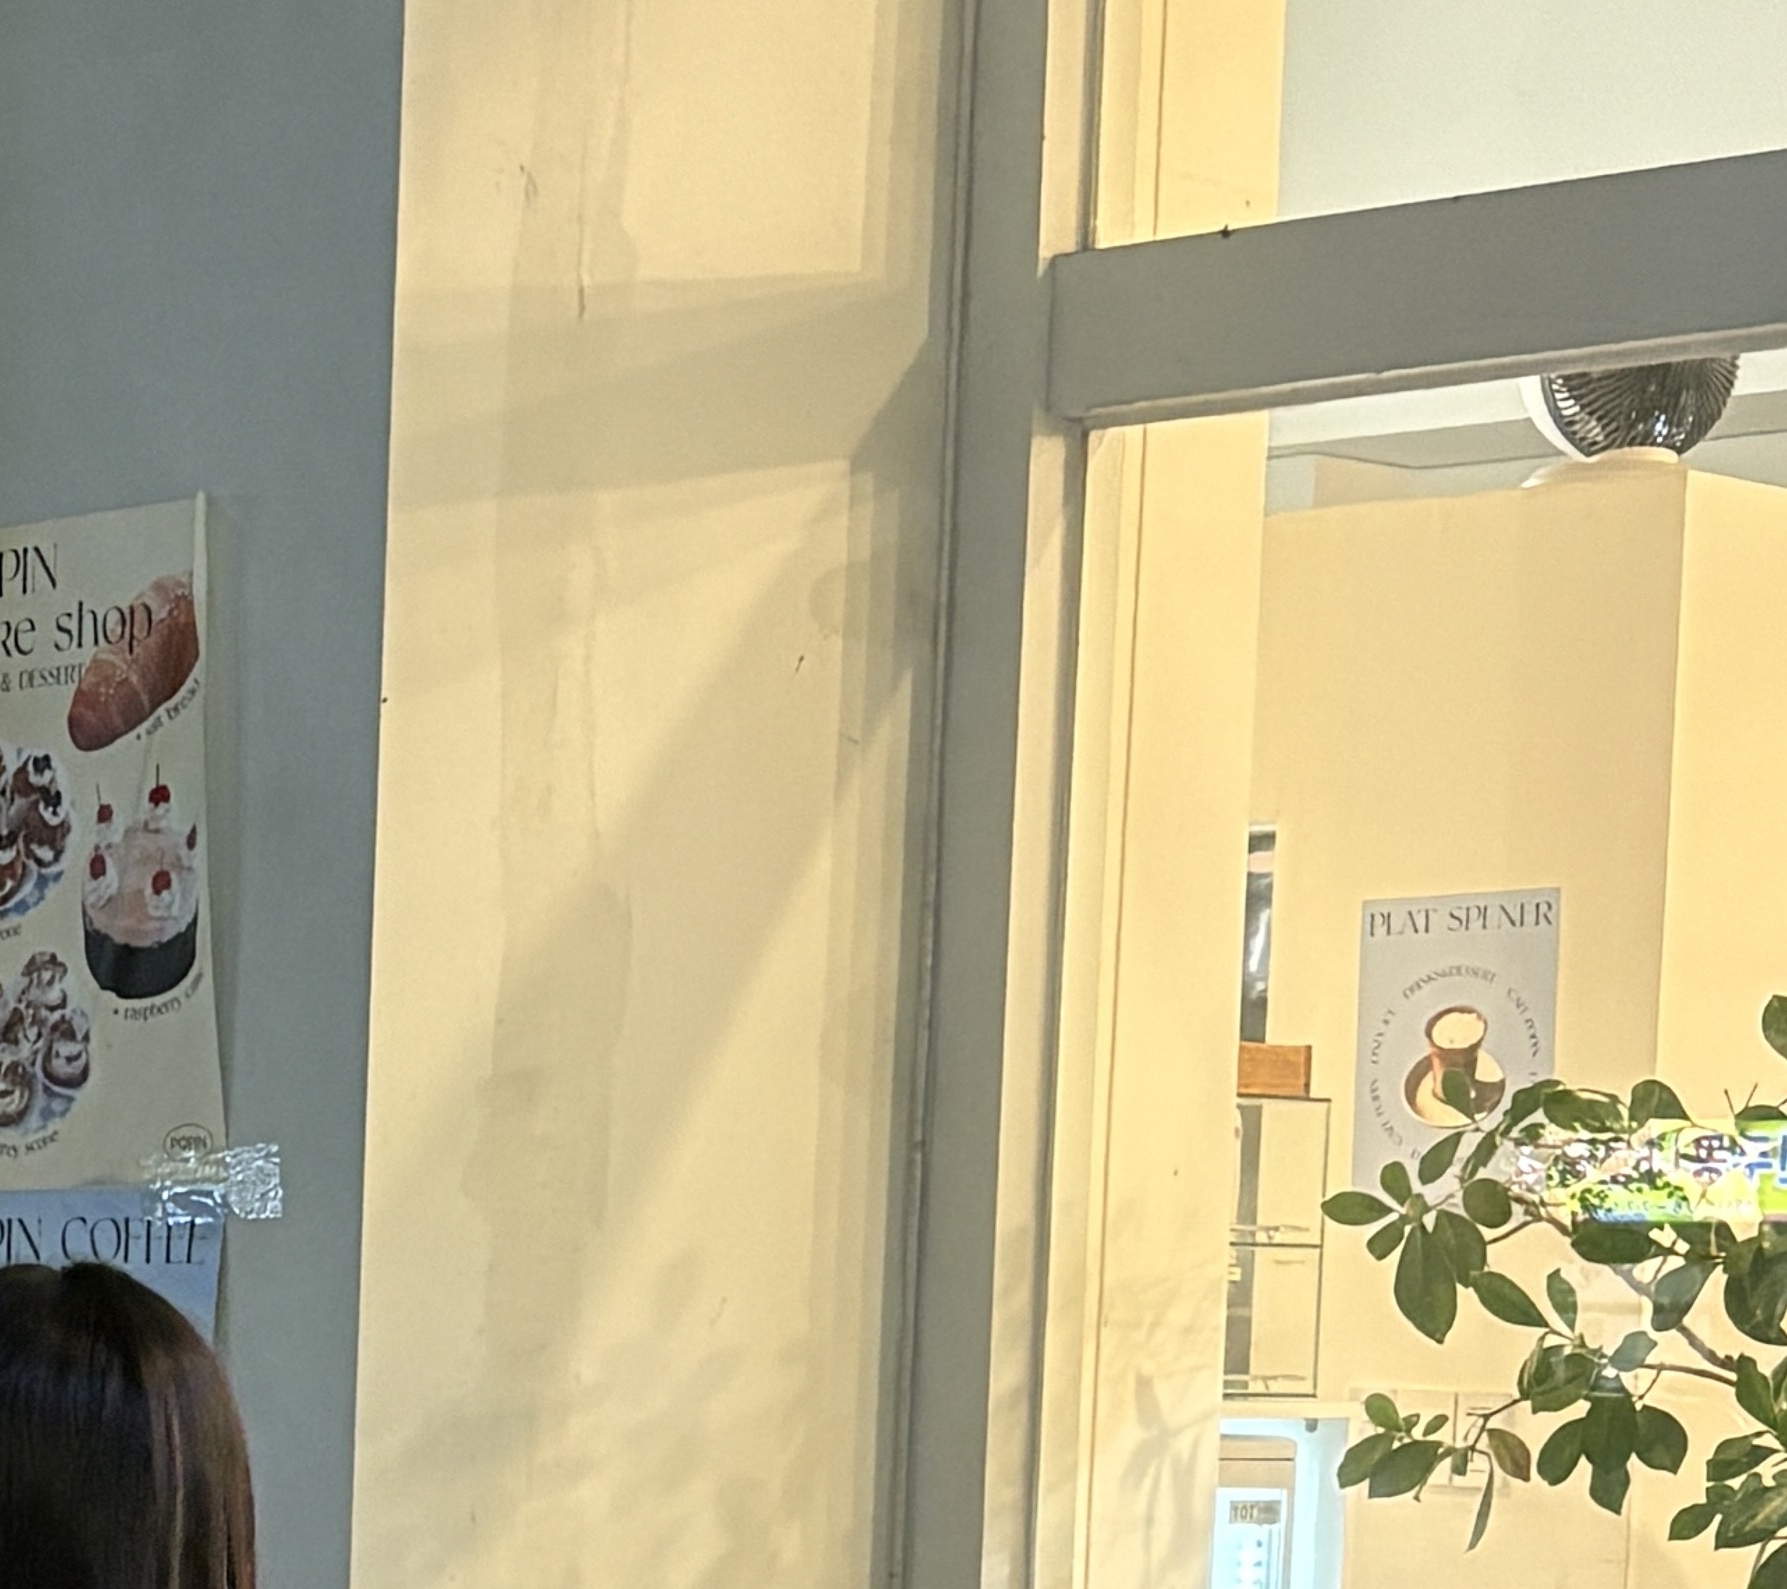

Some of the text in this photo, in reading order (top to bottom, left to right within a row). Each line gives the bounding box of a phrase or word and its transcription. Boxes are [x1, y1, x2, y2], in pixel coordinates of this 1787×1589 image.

[53, 600, 154, 657] shop
[0, 671, 11, 693] &
[18, 661, 88, 691] DESSERT
[1369, 907, 1439, 938] PLAT
